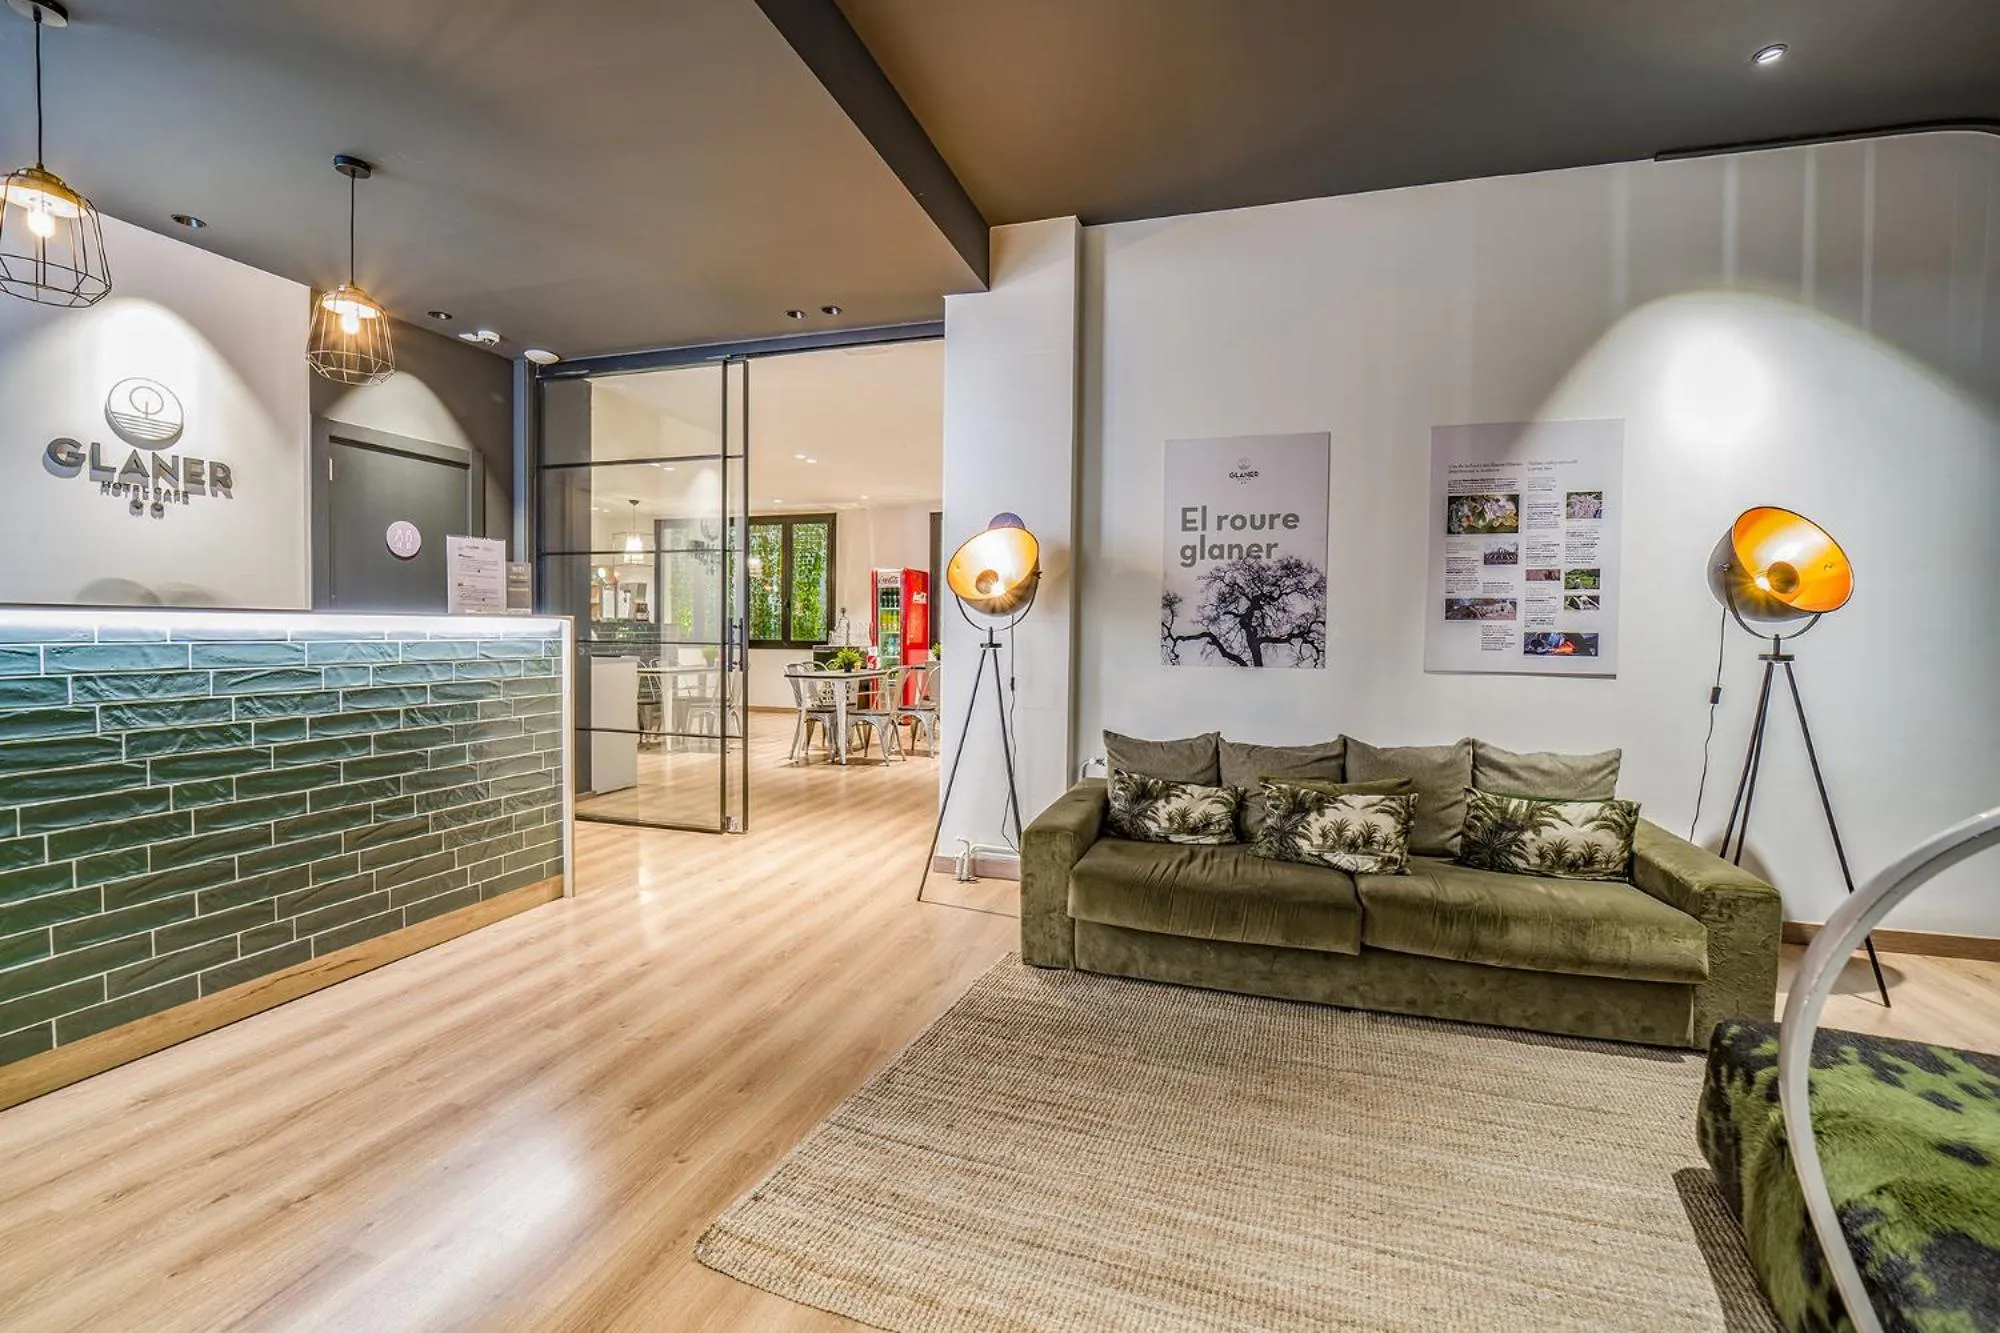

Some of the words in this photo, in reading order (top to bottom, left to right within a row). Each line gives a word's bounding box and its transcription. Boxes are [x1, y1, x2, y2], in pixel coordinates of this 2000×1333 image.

[43, 437, 234, 499] GLANER
[1181, 506, 1207, 531] El
[1216, 512, 1300, 531] roure
[1180, 534, 1278, 567] glaner
